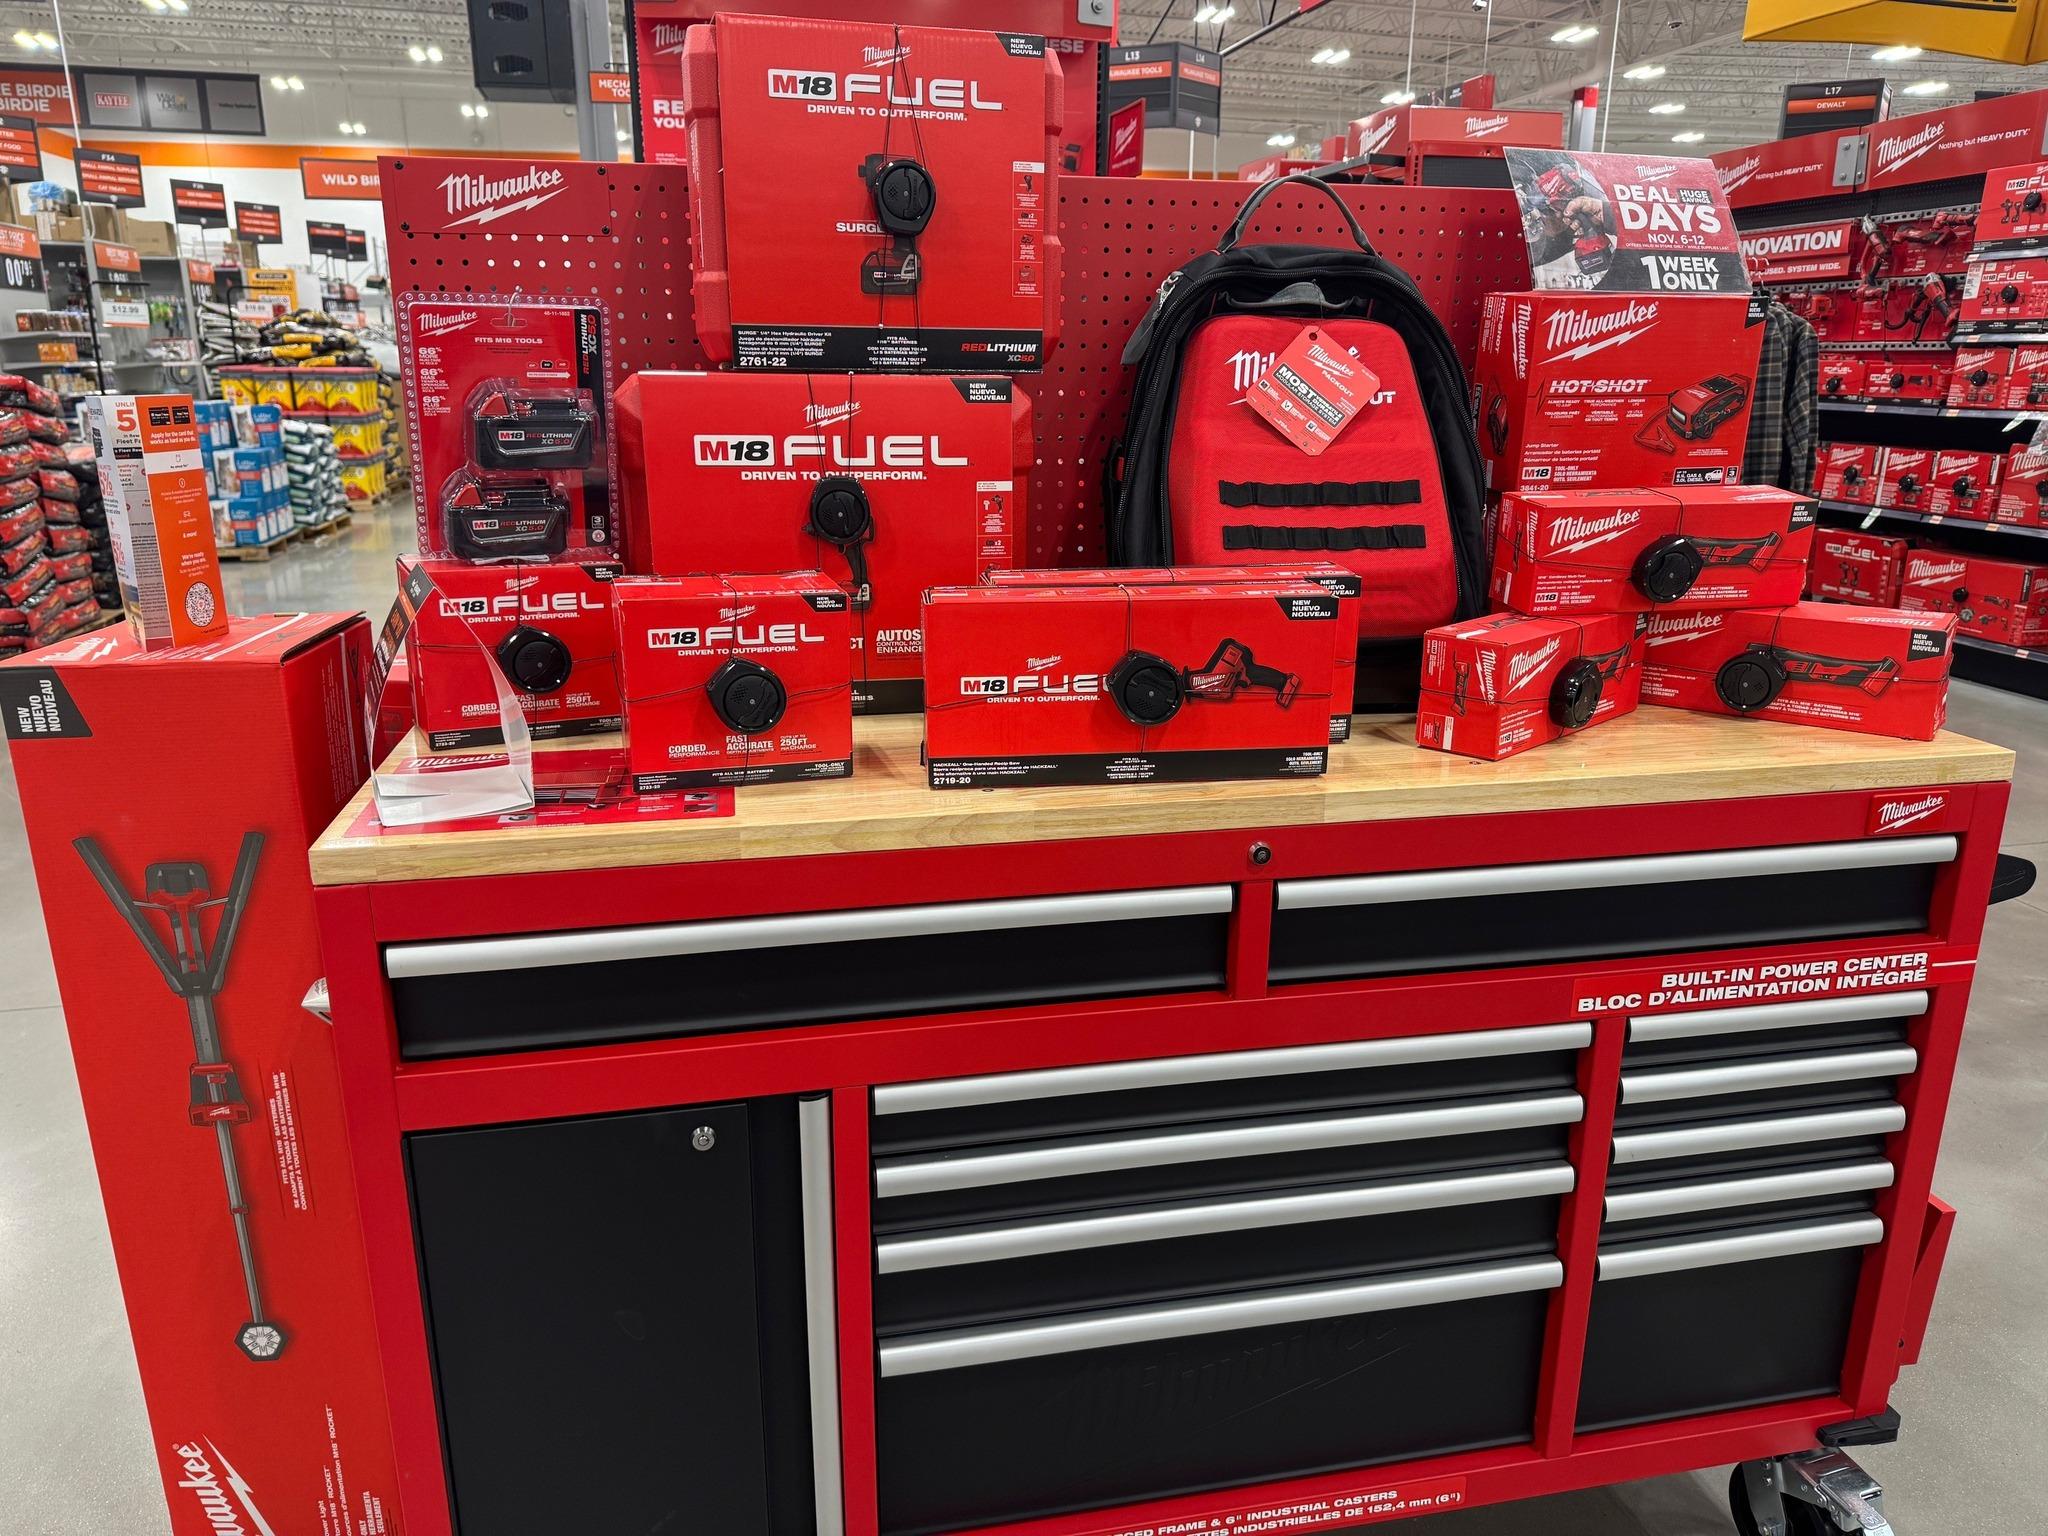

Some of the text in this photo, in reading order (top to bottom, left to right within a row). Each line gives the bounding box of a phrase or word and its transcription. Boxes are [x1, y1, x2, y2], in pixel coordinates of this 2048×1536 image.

[96, 94, 130, 107] KAYTEE
[770, 73, 1003, 111] M18 FUEL
[1824, 86, 1843, 96] L17
[807, 104, 968, 121] DRIVEN TO OUTPERFORM.
[1816, 101, 1847, 110] DEWALT
[1876, 121, 1946, 169] Milwaukee
[1938, 140, 1963, 151] Nothing
[1963, 138, 1976, 147] but
[1976, 133, 2003, 145] HEAVY
[321, 174, 358, 186] WILD
[1755, 171, 1771, 181] Nothing
[1783, 166, 1804, 176] HEAVY
[436, 164, 566, 215] Milwaukee
[1613, 184, 1709, 204] DEAL HUGE
[1617, 202, 1723, 235] DAYS
[1648, 233, 1706, 246] NOV. 6-12
[1641, 256, 1720, 290] 1 WEEK
[1663, 273, 1720, 290] ONLY
[416, 310, 478, 332] Milwaukee
[1541, 301, 1659, 351] Milwaukee
[475, 336, 494, 344] FITS
[495, 337, 512, 345] M18
[960, 342, 1038, 354] REDLITHIUM
[1517, 297, 1533, 380] Milwaukee
[739, 356, 788, 368] 2761-22
[1307, 344, 1356, 378] Milwaukee
[1956, 350, 1996, 368] Milwaukee
[1278, 365, 1318, 401] MOST
[1321, 369, 1355, 398] PACKOUT
[802, 400, 862, 422] Milwaukee
[697, 434, 969, 466] M18 FUEL
[1940, 455, 1980, 471] Milwaukee
[741, 470, 798, 481] DRIVEN
[800, 470, 821, 481] TO
[1547, 508, 1641, 547] Milwaukee
[1842, 544, 1880, 561] FUEL
[1909, 558, 1967, 579] Milwaukee
[441, 591, 605, 614] M18 FUEL
[467, 615, 503, 624] DRIVEN
[519, 612, 581, 622] OUTPERFORM.
[651, 623, 825, 647] M18 FUEL
[1913, 632, 1928, 640] NEW
[678, 645, 799, 657] DRIVEN TO OUTPERFORM.
[1911, 645, 1940, 653] NOUVEAU
[1025, 654, 1062, 670] Milwaukee
[1508, 636, 1562, 684] Milwaukee
[963, 674, 1111, 694] M18 FUE
[1479, 648, 1496, 706] Milwaukee
[41, 678, 62, 732] NOUVEAU
[461, 703, 498, 714] CORDED
[1037, 695, 1101, 703] OUTPERFORM.
[20, 706, 35, 734] NEW
[28, 694, 48, 733] NUEVO
[668, 744, 707, 755] CORDED
[726, 735, 748, 744] FAST
[726, 741, 774, 751] ACCURATE
[668, 749, 721, 759] PERFORMANCE
[933, 776, 972, 786] 2719-20
[1877, 794, 1946, 824] Milwaukee
[1661, 952, 1929, 989] BUILT-IN POWER CENTER
[1577, 993, 1642, 1013] BLOC
[1836, 966, 1928, 990] INTÉGRÉ
[269, 1097, 281, 1137] BATTERIES
[279, 1154, 287, 1169] ALL
[281, 1168, 290, 1185] FITS
[326, 1407, 352, 1536] ources d'alimentation M18 ROCKET
[323, 1467, 334, 1499] ROCKET
[329, 1502, 338, 1518] M18
[1158, 1520, 1208, 1536] FRAME
[1210, 1517, 1222, 1527] &
[1225, 1513, 1243, 1525] 6"
[1246, 1500, 1331, 1522] INDUSTRIAL
[1334, 1490, 1399, 1508] CASTERS
[1232, 1511, 1342, 1536] INDUSTRIELLES
[1344, 1506, 1365, 1518] DE
[1367, 1500, 1407, 1516] 152,4
[1408, 1497, 1433, 1509] mm
[1434, 1491, 1462, 1506] (6")
